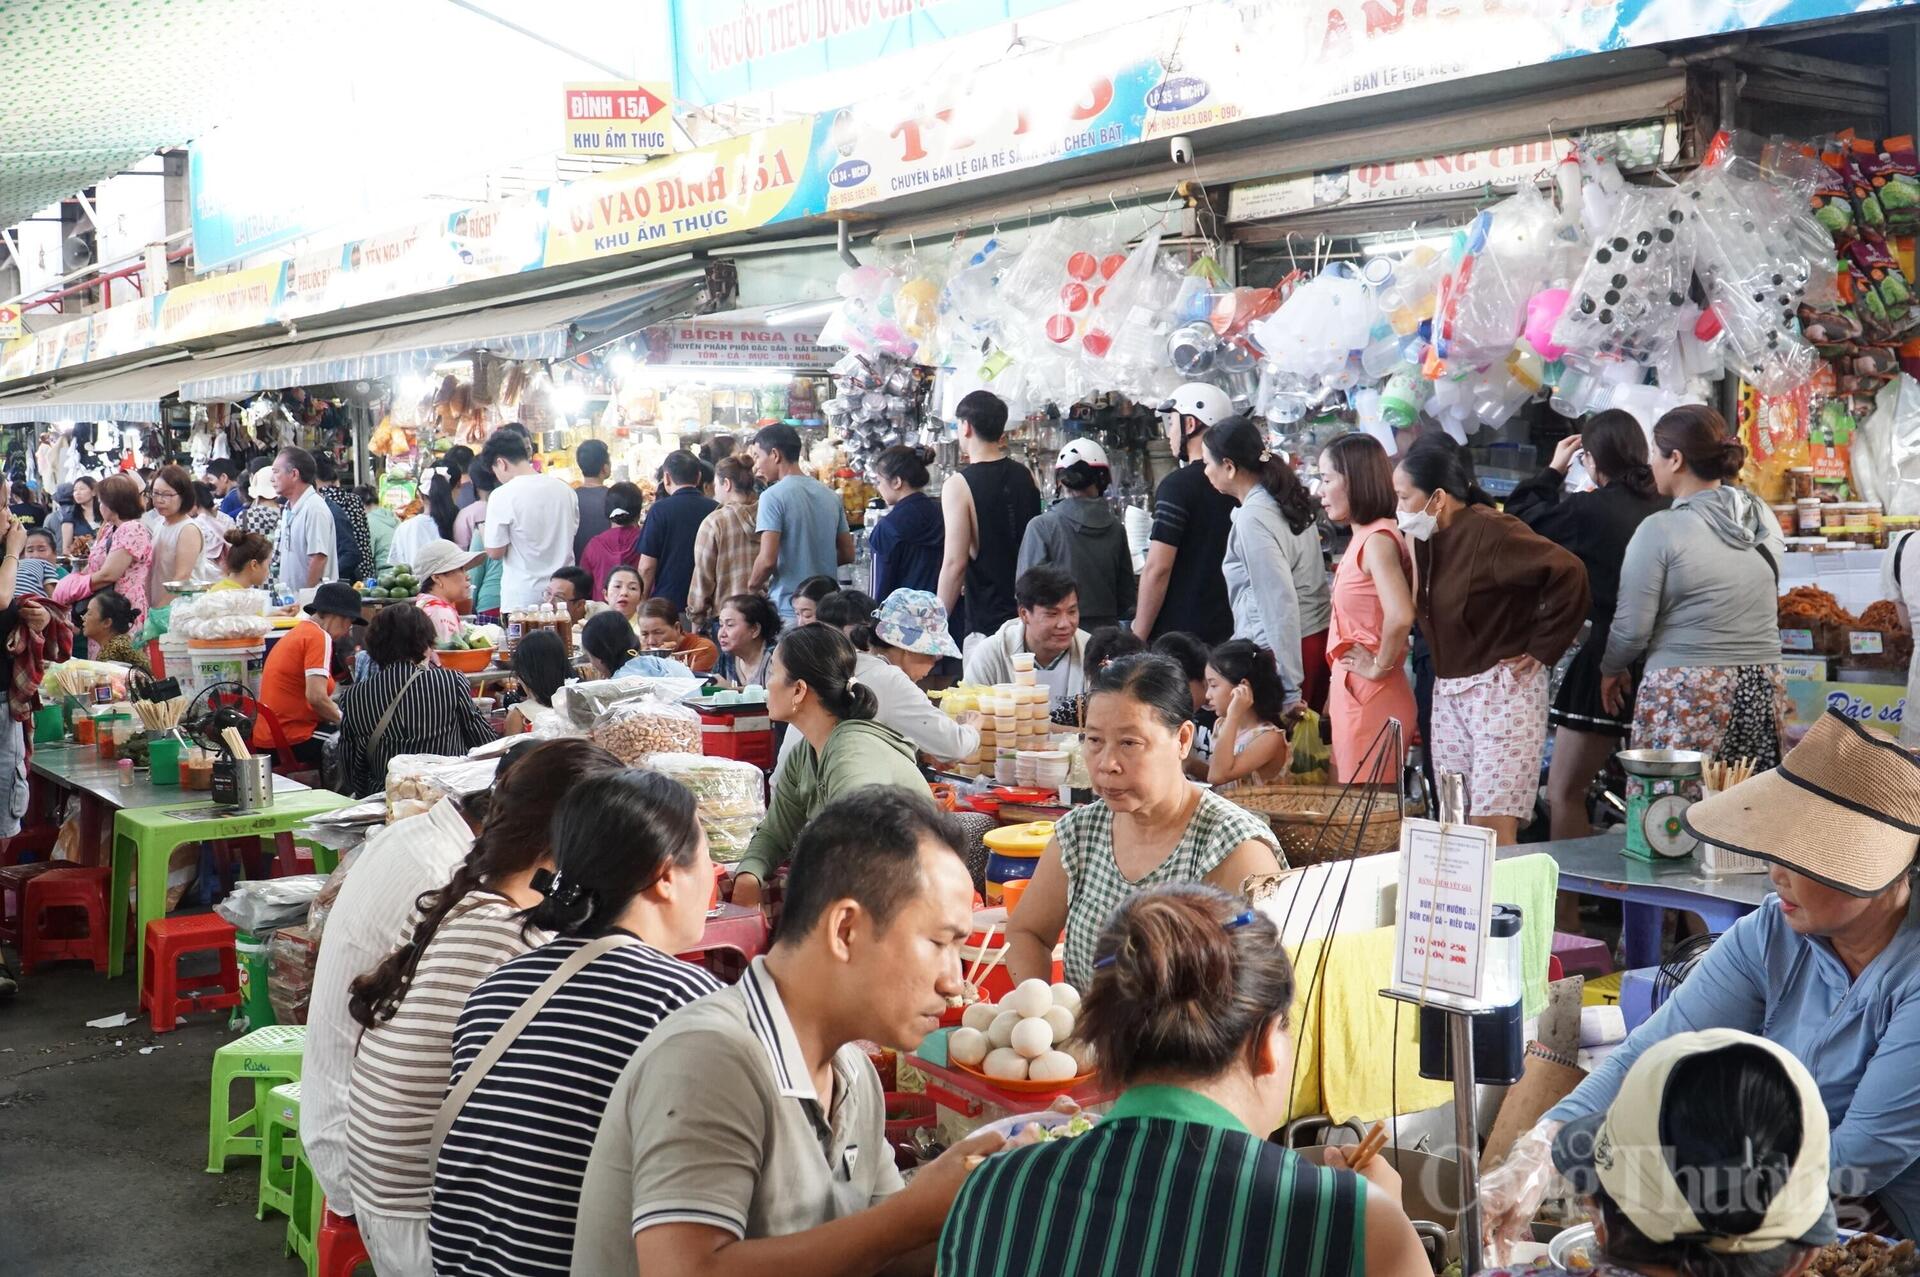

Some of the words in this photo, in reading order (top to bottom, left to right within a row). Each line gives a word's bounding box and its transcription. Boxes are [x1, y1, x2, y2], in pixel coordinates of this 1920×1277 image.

[572, 94, 612, 118] ĐÌNH
[617, 97, 650, 117] 15A
[573, 132, 600, 149] KHU
[605, 126, 627, 149] ẨM
[632, 131, 665, 151] THỰC
[1357, 151, 1477, 188] QUANG
[594, 230, 630, 251] KHU
[637, 220, 667, 243] ẨM
[673, 209, 729, 235] THỰC
[741, 330, 785, 343] NGA
